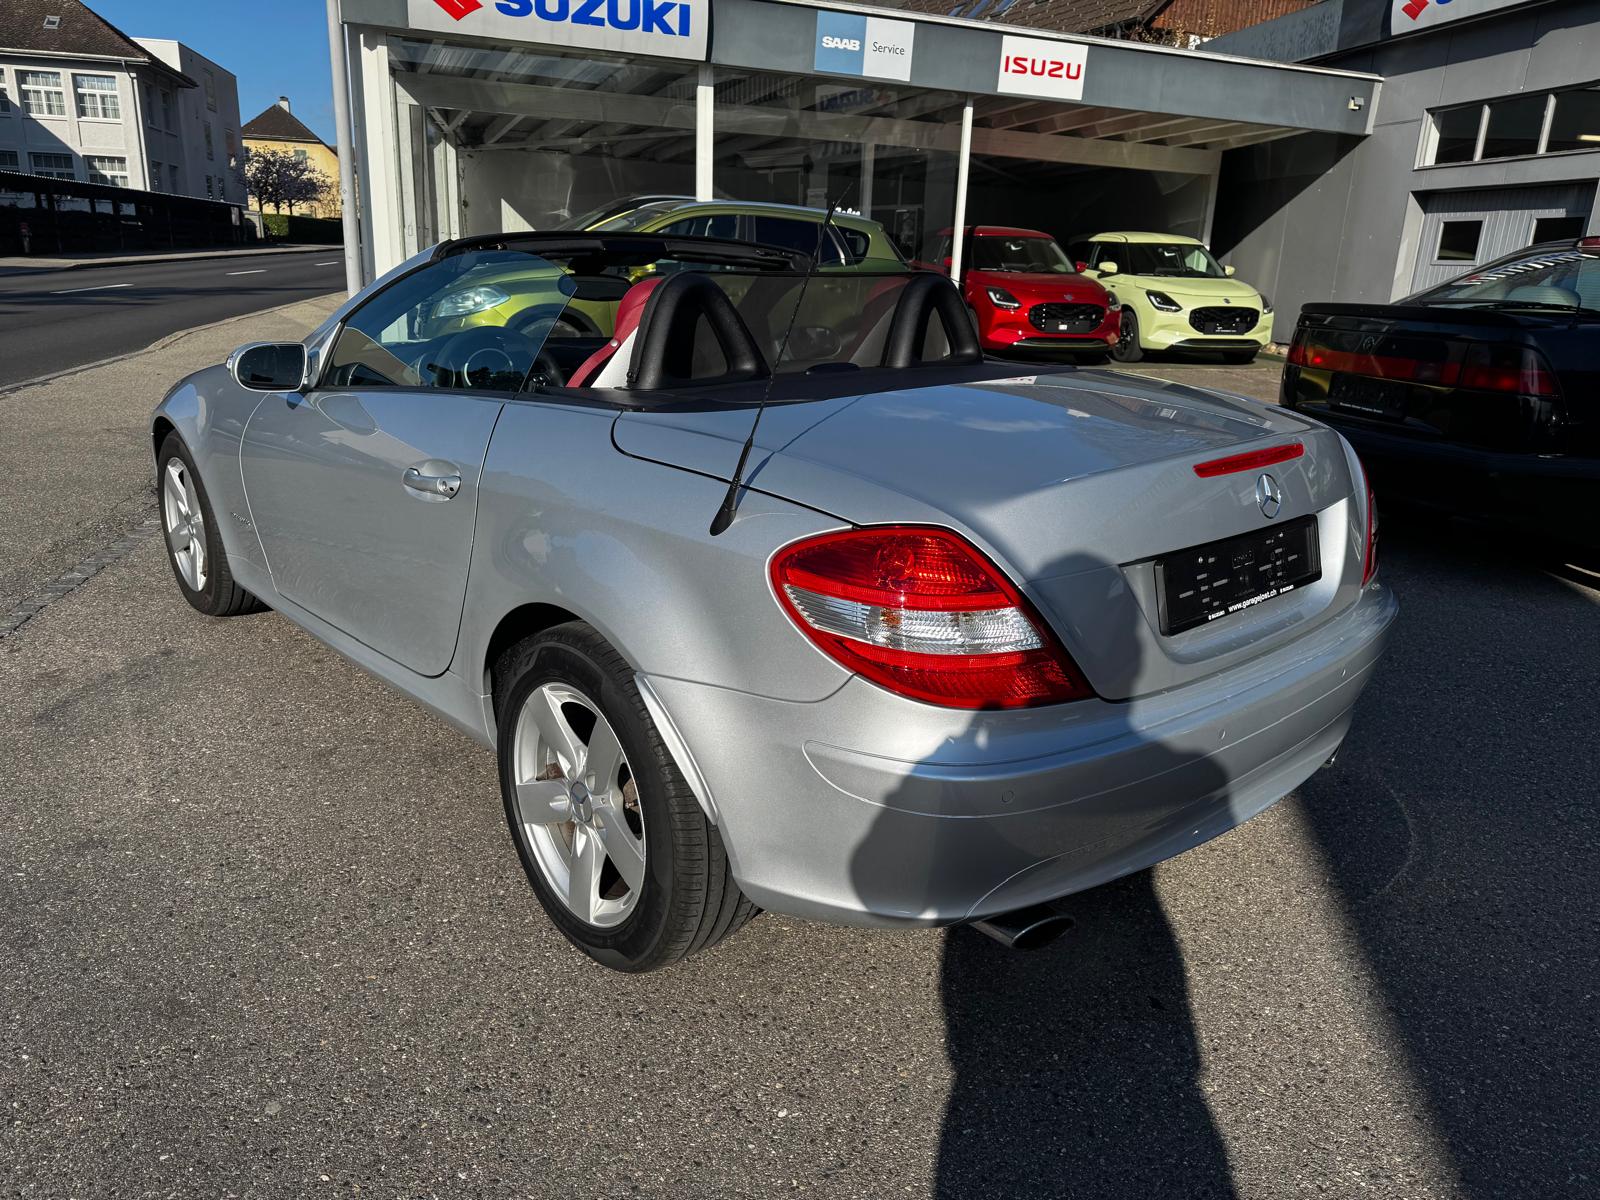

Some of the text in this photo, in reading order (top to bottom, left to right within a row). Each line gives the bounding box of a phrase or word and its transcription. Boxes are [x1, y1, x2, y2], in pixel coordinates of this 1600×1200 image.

[822, 36, 905, 55] SAAB Service
[1004, 55, 1081, 80] ISUZU
[1228, 588, 1277, 612] www.garagejost.ch
